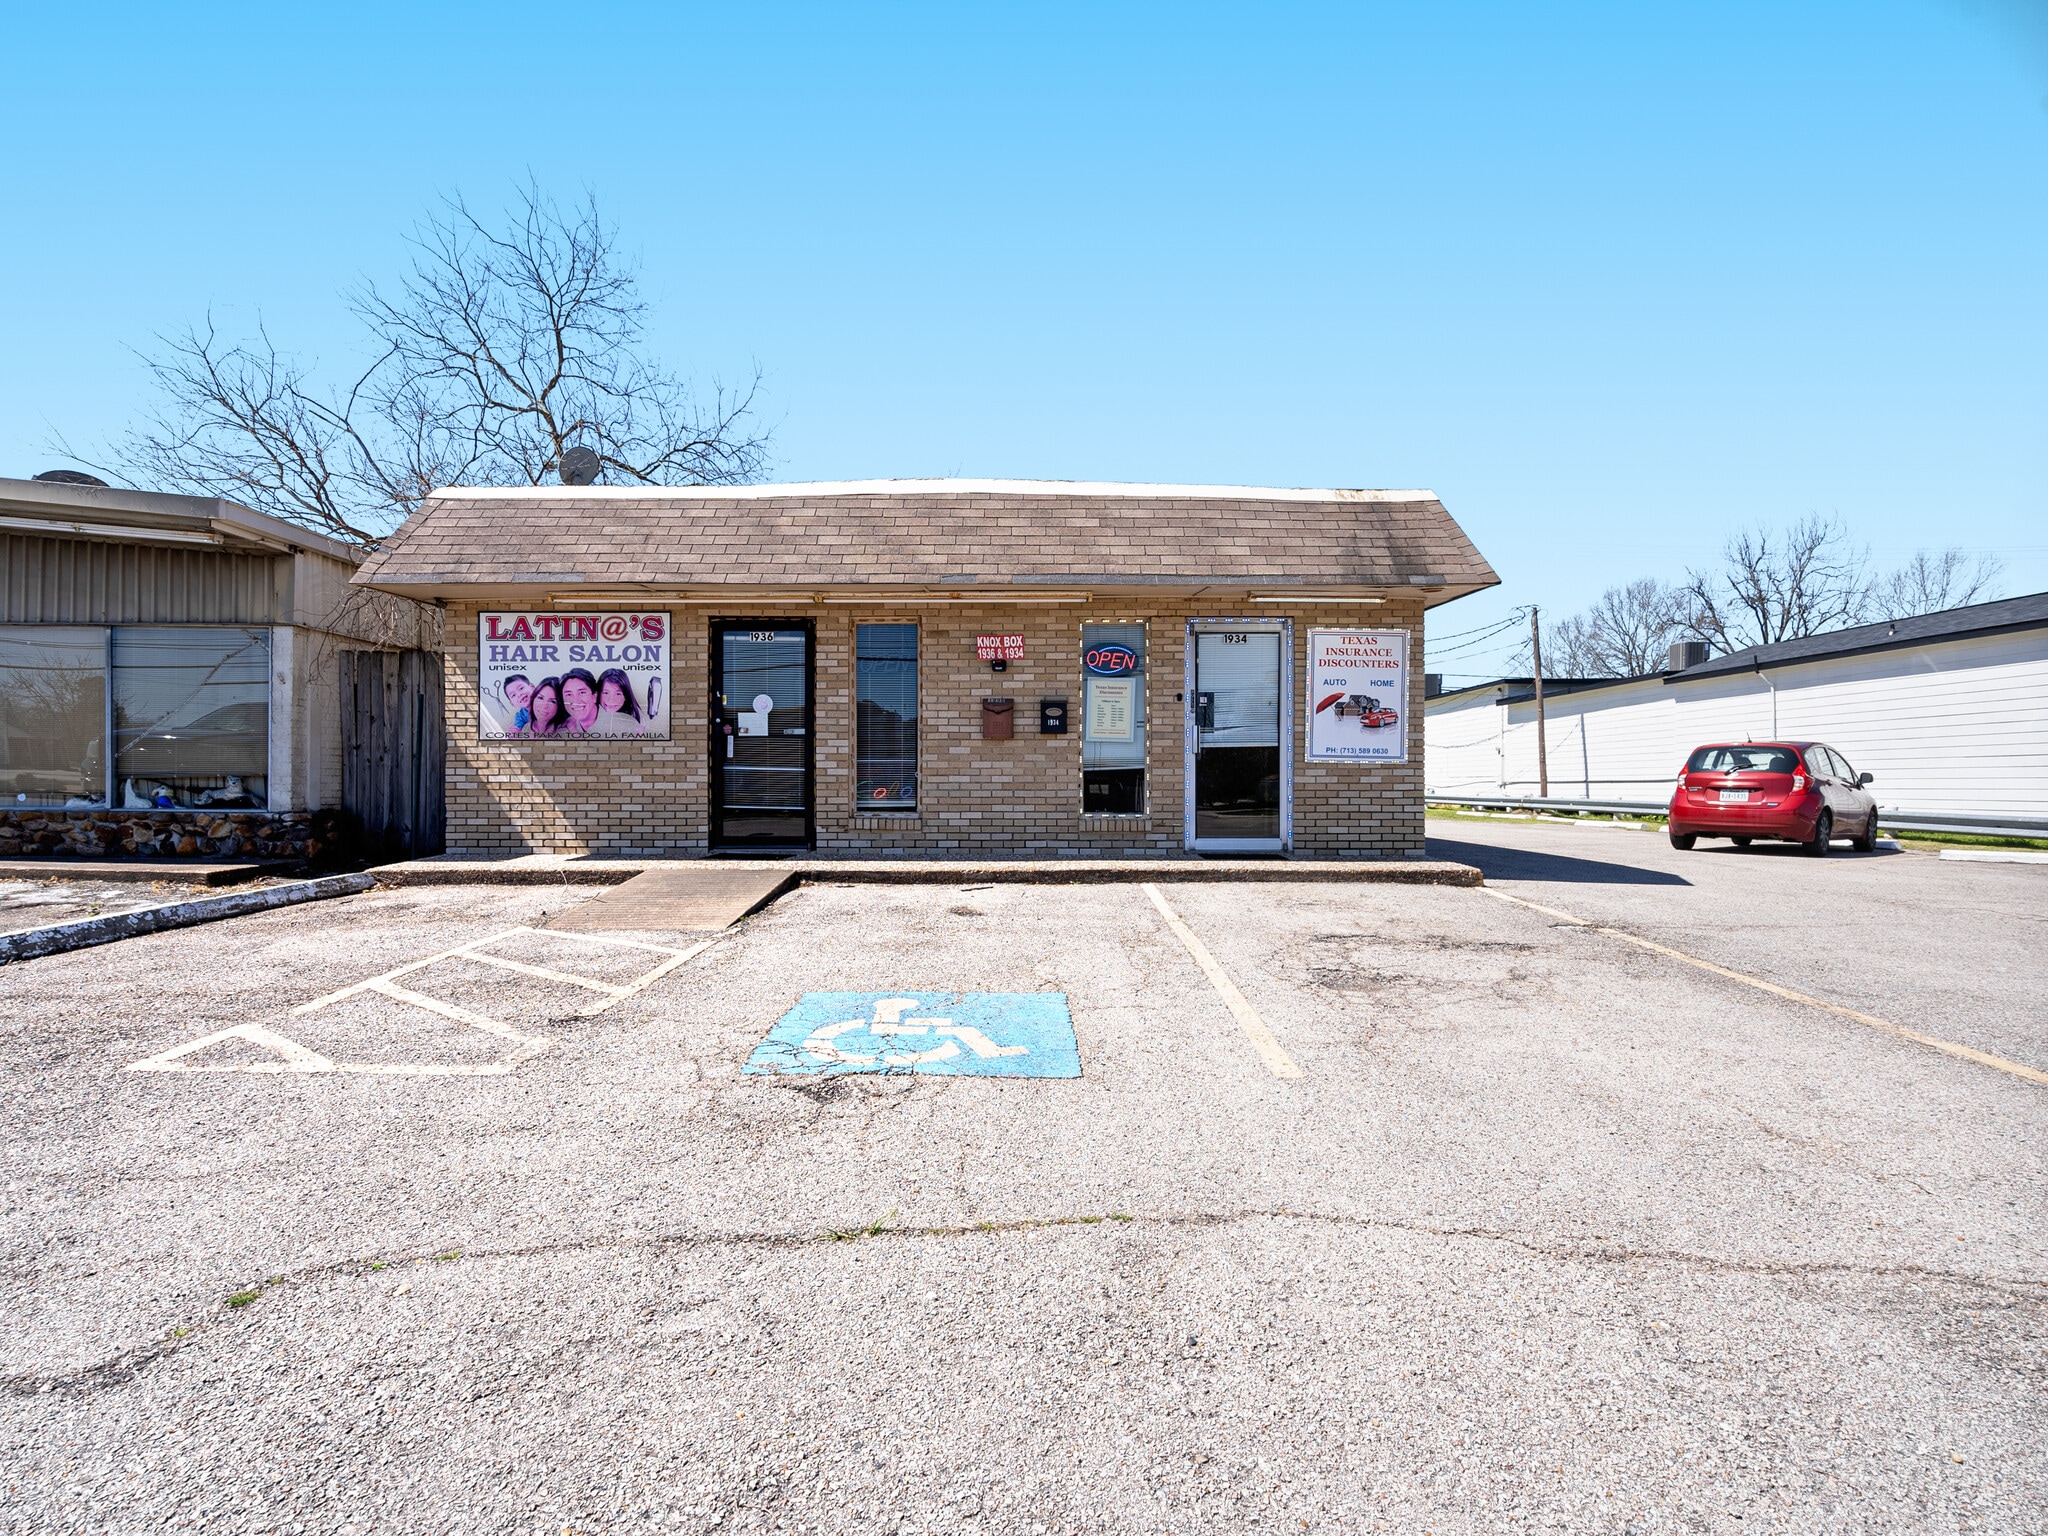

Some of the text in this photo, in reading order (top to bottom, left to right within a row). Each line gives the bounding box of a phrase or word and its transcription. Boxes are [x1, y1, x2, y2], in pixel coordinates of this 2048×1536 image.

[750, 632, 774, 641] 1936
[976, 635, 1023, 648] KNOX BOX
[1224, 634, 1247, 644] 1934
[1340, 636, 1378, 645] TEXAS
[489, 645, 662, 662] HAIR SALON
[977, 647, 1024, 659] 1936 & 1934
[1325, 647, 1393, 657] INSURANCE
[1086, 650, 1136, 670] OPEN
[1318, 659, 1399, 669] DISCOUNTERS
[488, 663, 527, 671] unisex
[622, 663, 662, 671] unisex
[1339, 747, 1357, 755] (713)
